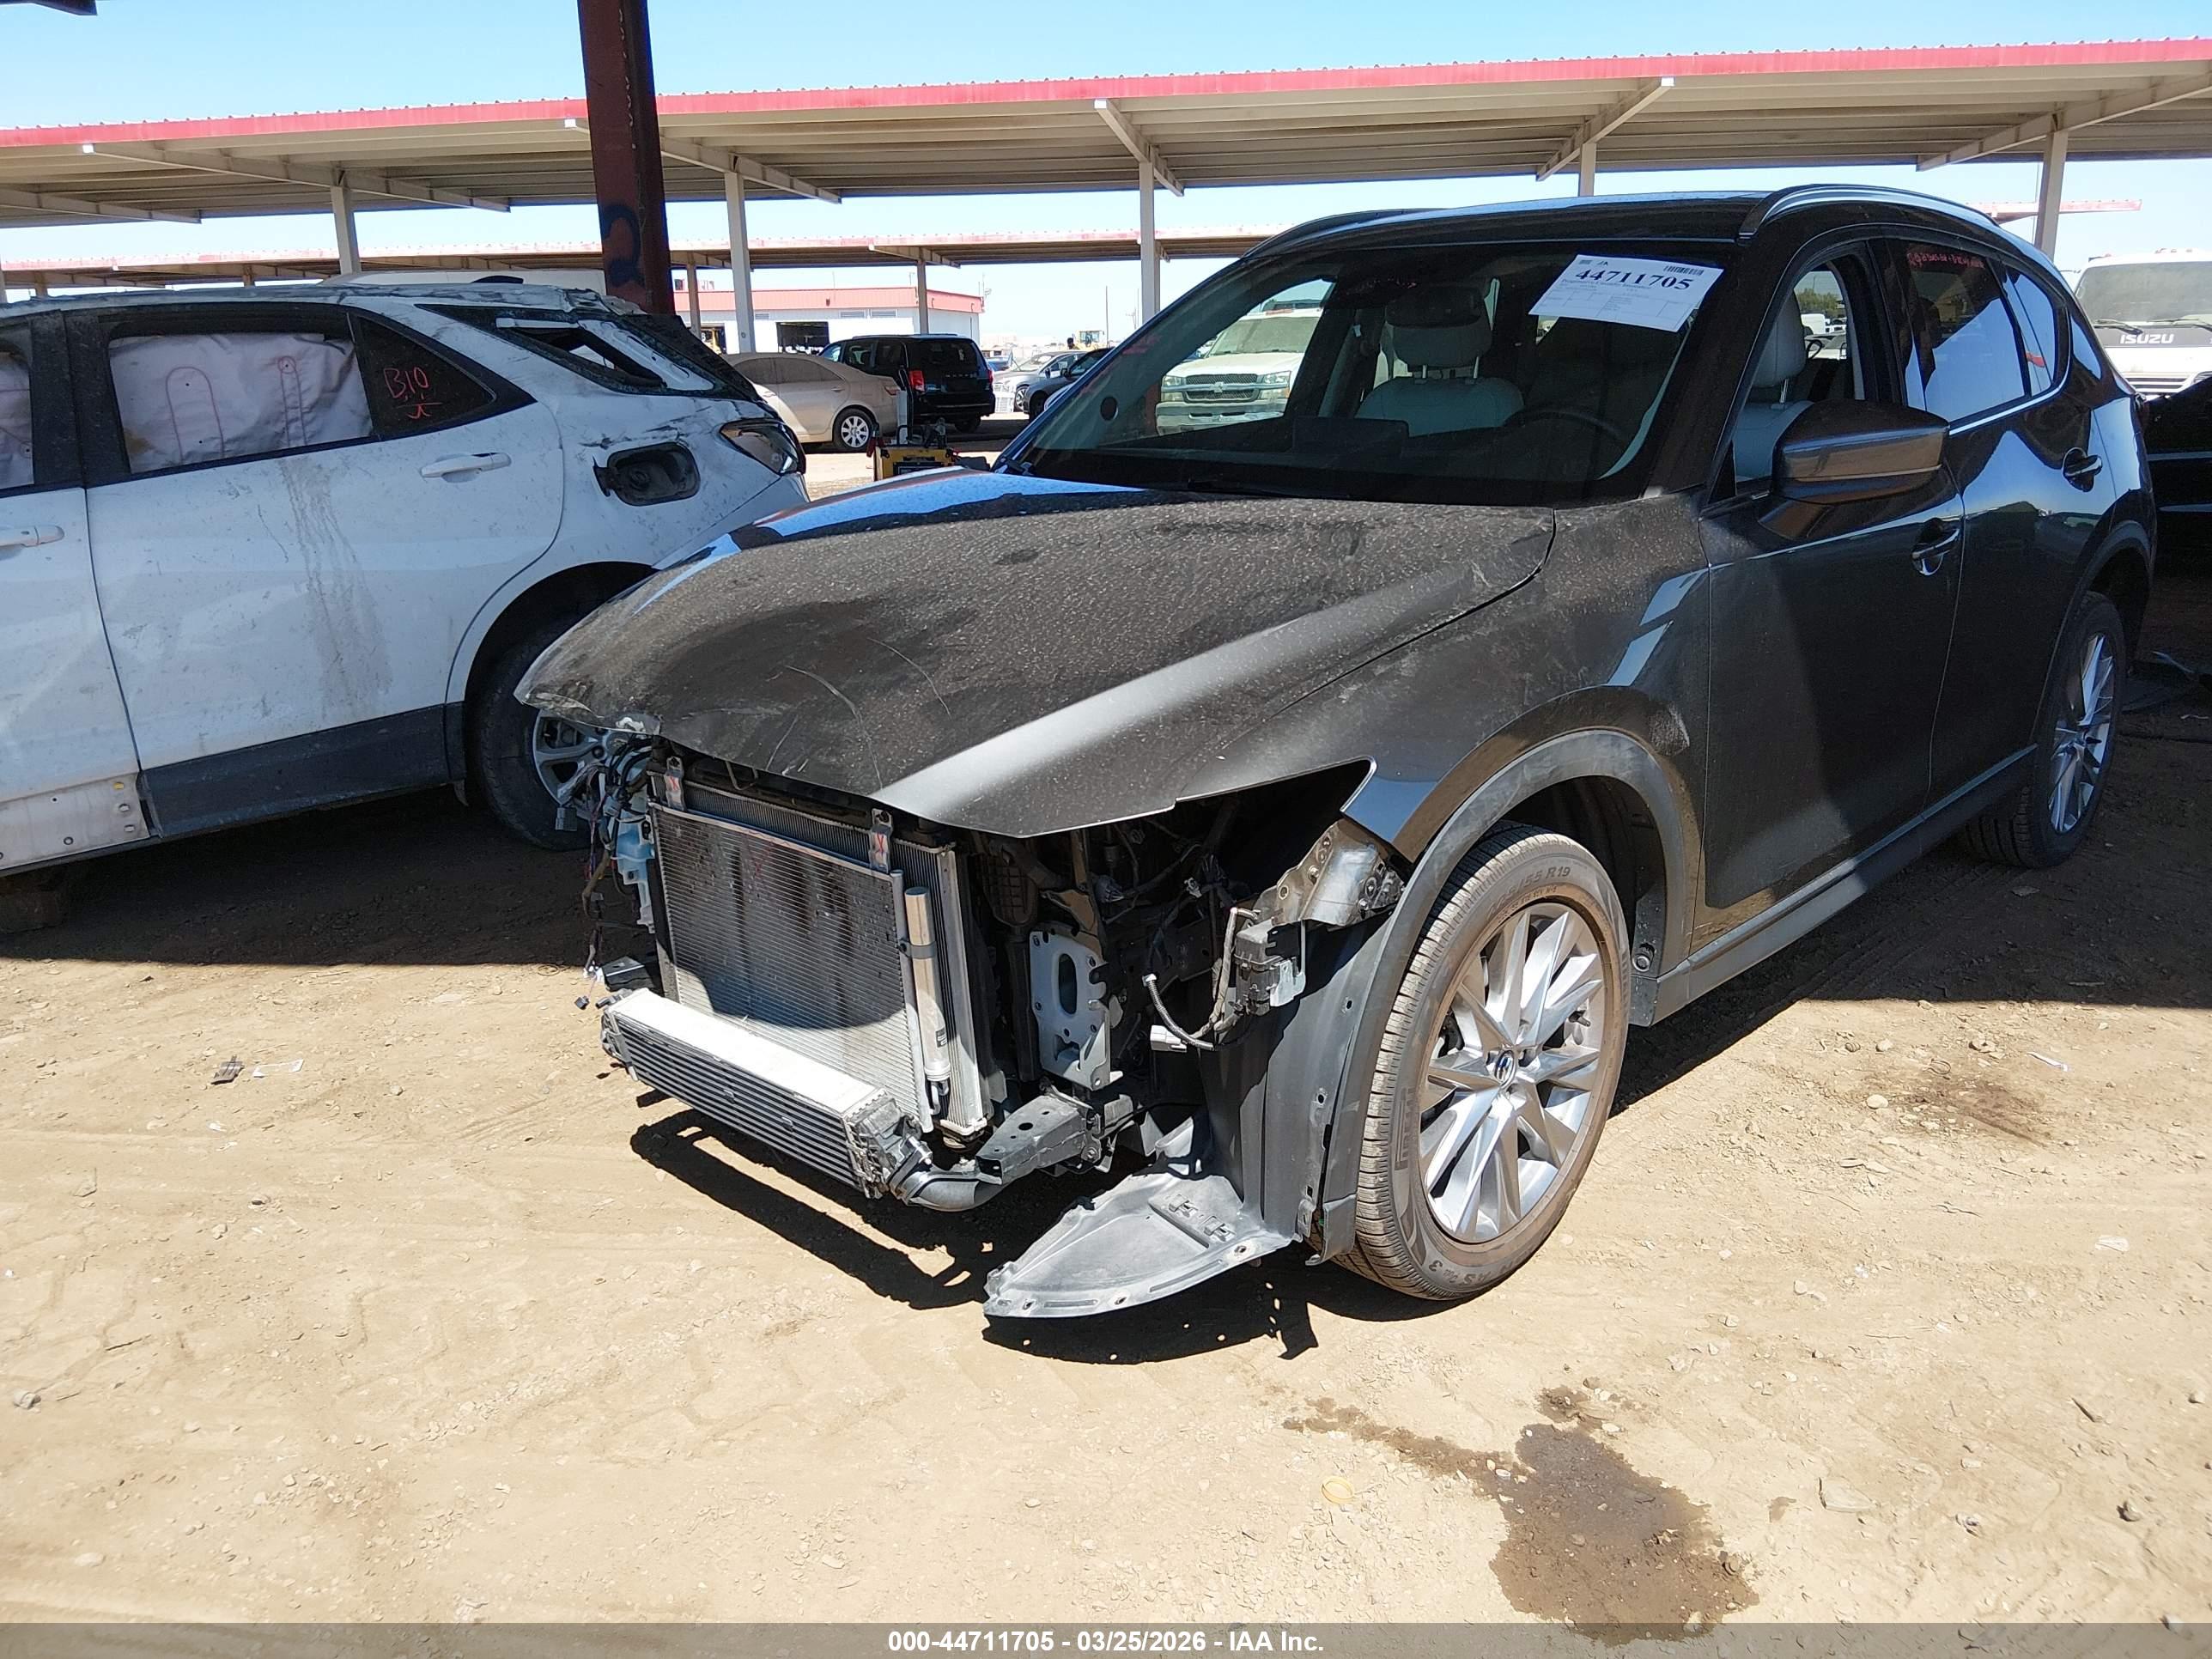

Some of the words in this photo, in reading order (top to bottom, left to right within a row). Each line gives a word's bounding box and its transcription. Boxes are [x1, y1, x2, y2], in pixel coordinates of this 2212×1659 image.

[1576, 268, 1694, 291] 44711705
[2120, 333, 2175, 344] ISUZU
[1546, 866, 1571, 879] R19
